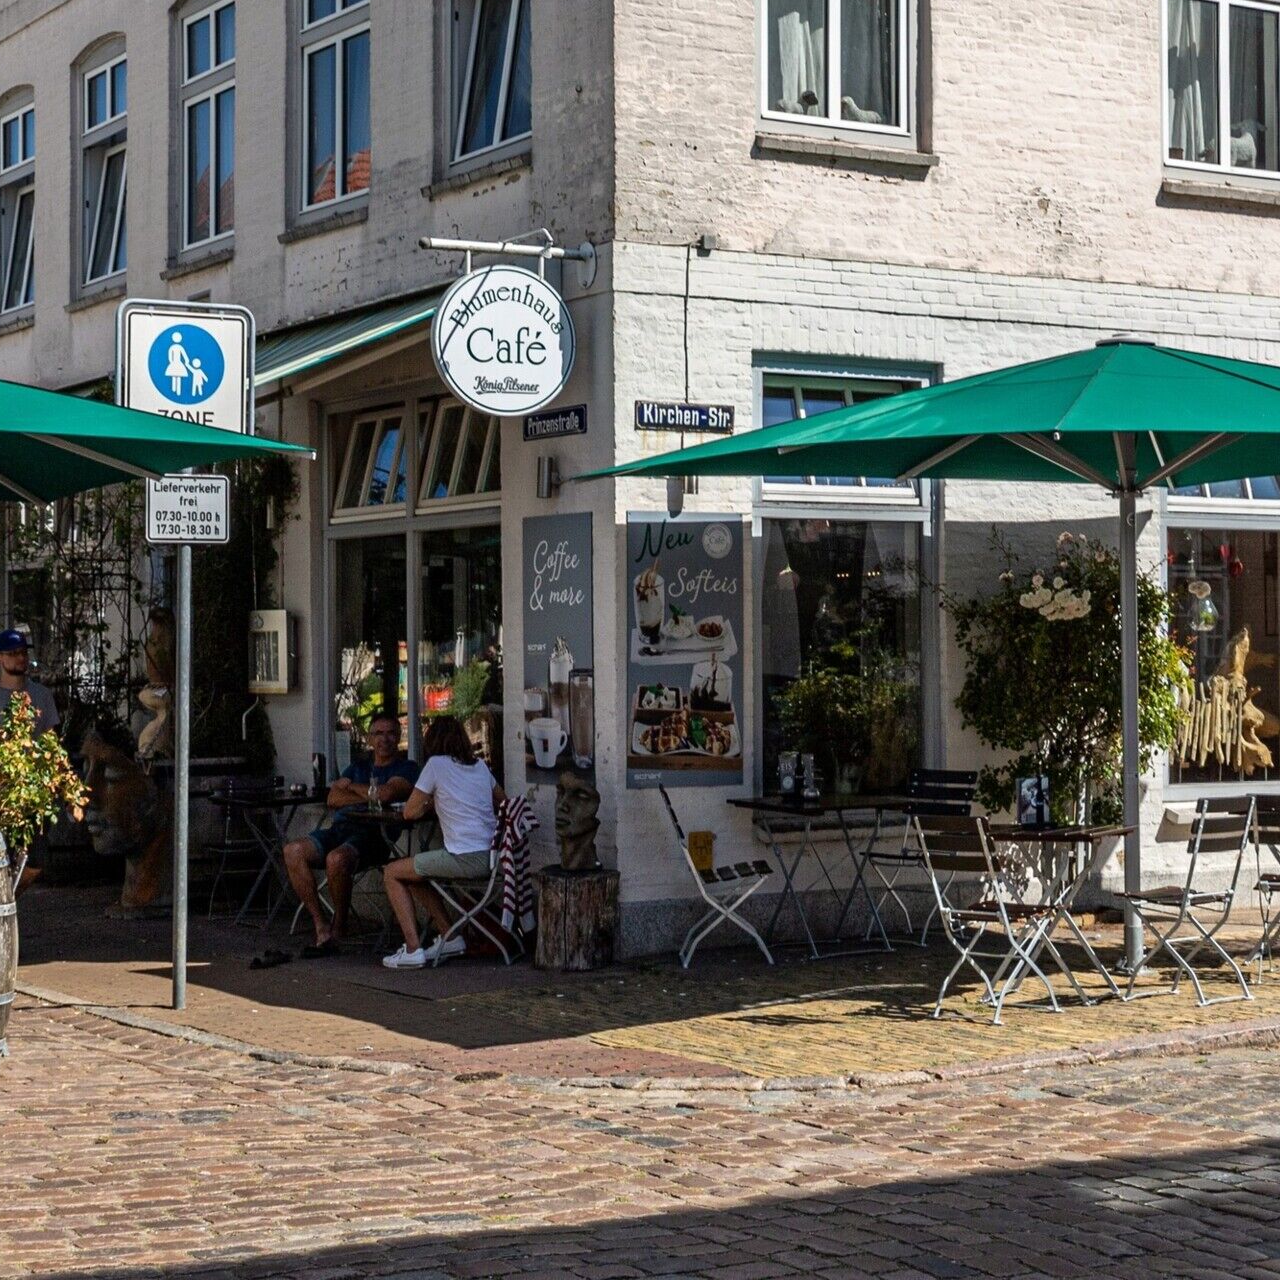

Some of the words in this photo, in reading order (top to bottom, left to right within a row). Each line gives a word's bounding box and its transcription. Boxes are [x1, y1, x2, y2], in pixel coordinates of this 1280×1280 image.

[449, 284, 564, 335] Blumenhaus
[466, 327, 547, 365] Café
[527, 413, 580, 435] Prinzenstraße
[643, 403, 731, 429] Kirchen-Str.
[153, 482, 222, 494] Lieferverkehr
[179, 496, 198, 506] frei
[155, 511, 213, 522] 07.30-10.00
[215, 513, 221, 522] h
[156, 524, 212, 535] 17.30-18.30
[214, 525, 220, 535] h
[635, 519, 695, 563] Neu
[533, 540, 580, 583] Coffee
[529, 575, 544, 611] &
[549, 587, 585, 606] more
[668, 567, 738, 604] Softeis
